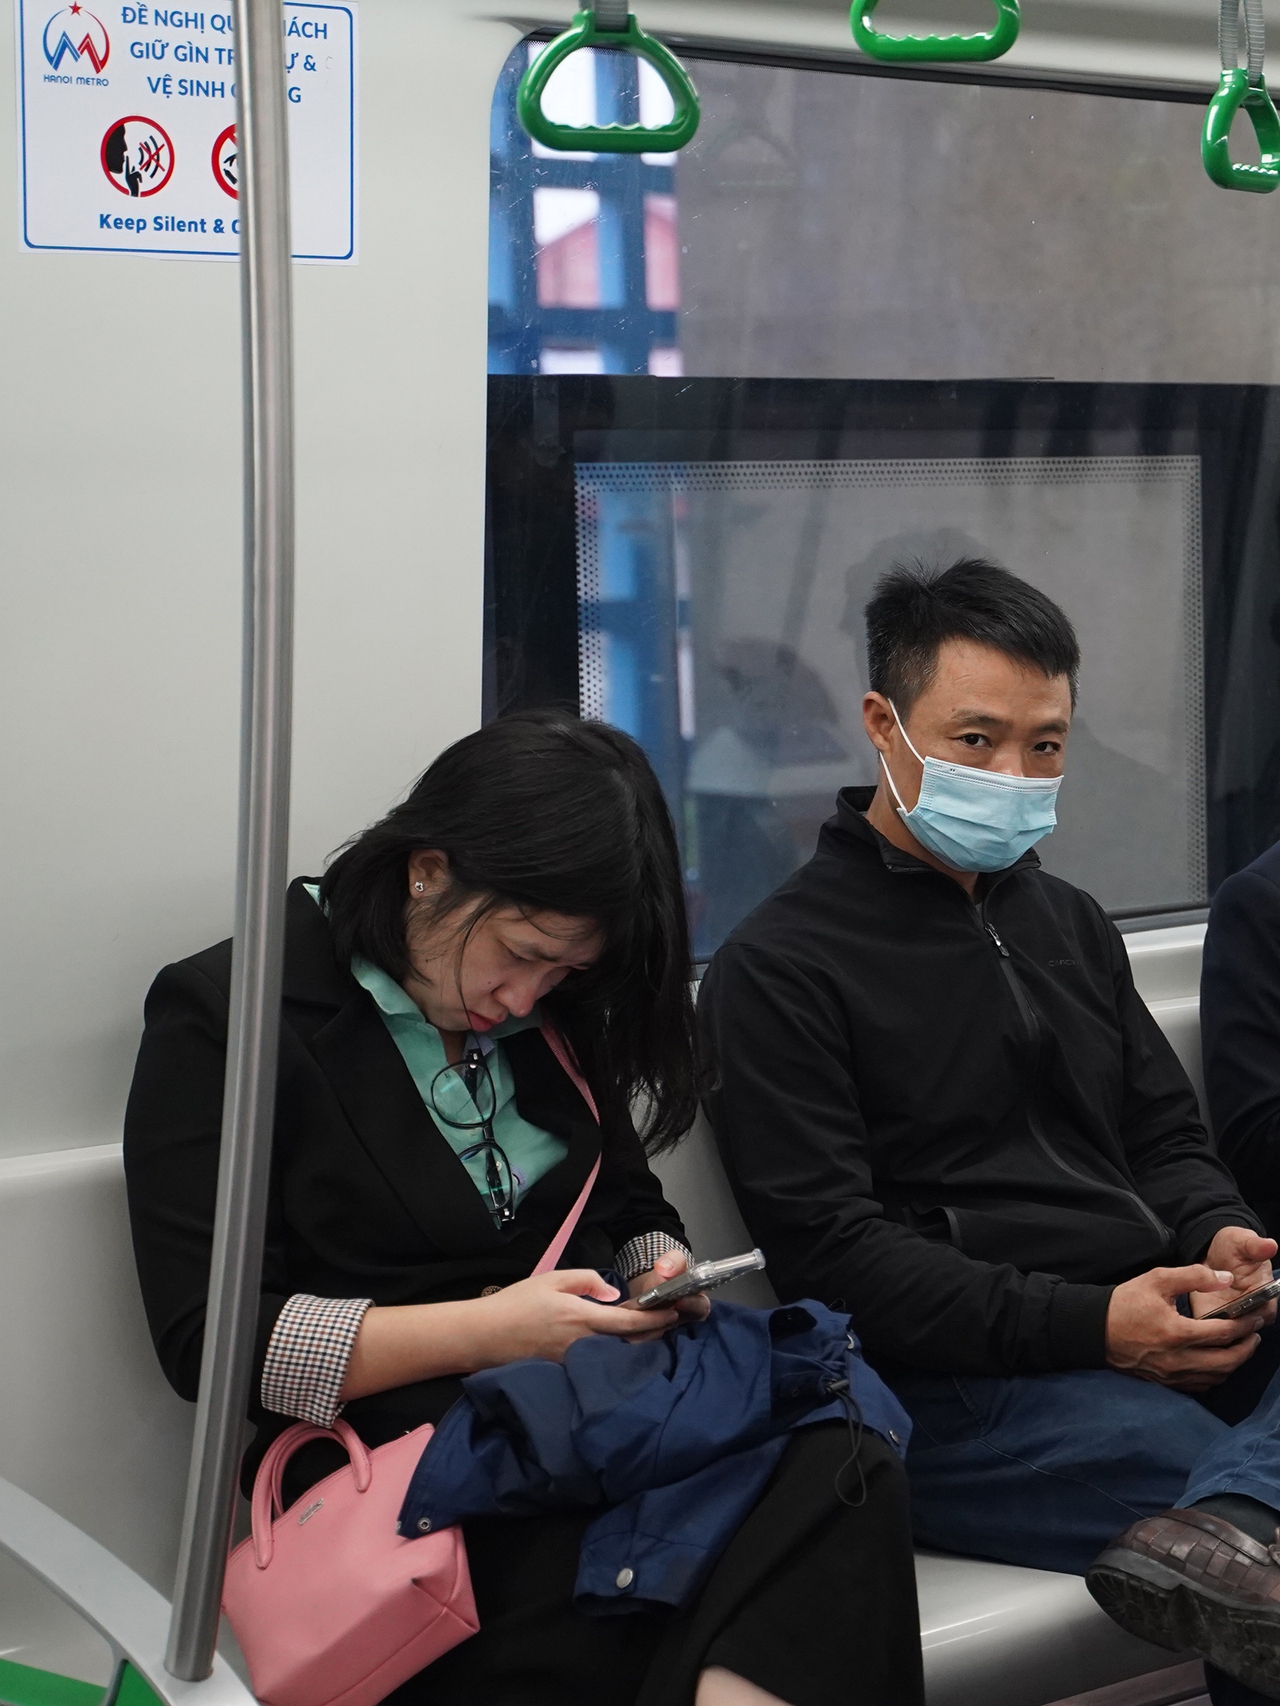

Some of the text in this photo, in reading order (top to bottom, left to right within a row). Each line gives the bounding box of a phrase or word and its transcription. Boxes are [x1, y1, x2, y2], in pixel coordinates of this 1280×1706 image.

[121, 1, 149, 25] ĐỀ
[154, 9, 205, 34] NGHỊ
[130, 39, 170, 61] GIỮ
[173, 41, 209, 64] GÌN
[303, 54, 317, 72] &
[146, 73, 173, 99] VỆ
[178, 78, 225, 99] SINH
[99, 213, 147, 234] Keep
[153, 215, 207, 234] Silent
[212, 218, 225, 234] &
